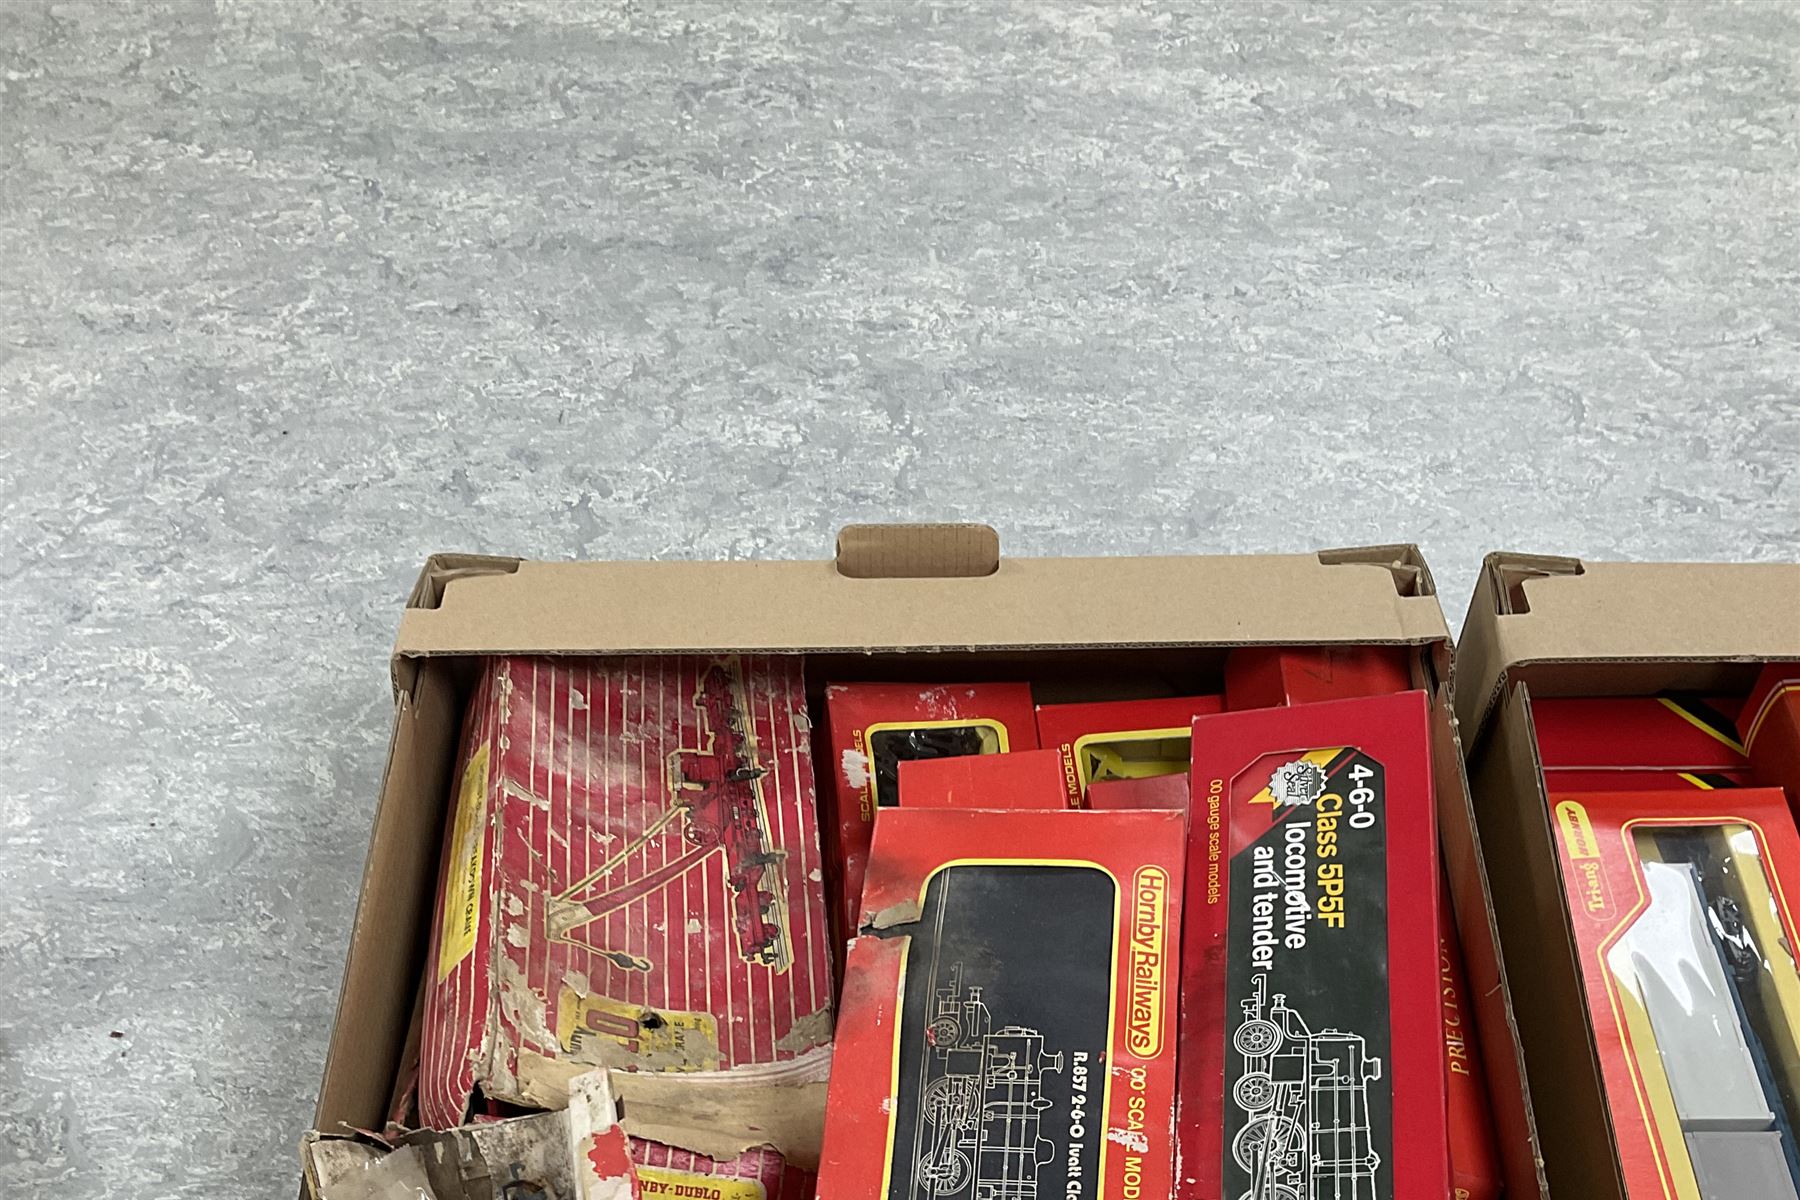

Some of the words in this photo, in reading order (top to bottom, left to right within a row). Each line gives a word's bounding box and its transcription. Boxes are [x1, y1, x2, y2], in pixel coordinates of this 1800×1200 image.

[1061, 743, 1078, 795] MODELS
[1283, 771, 1297, 799] Seal
[1296, 764, 1313, 800] Silver
[1207, 796, 1221, 830] gauge
[1348, 763, 1376, 829] 4-6-0
[1208, 831, 1220, 861] scale
[1315, 793, 1343, 859] Class
[1565, 806, 1588, 857] HORNBY
[1207, 863, 1221, 904] models
[1253, 846, 1279, 889] and
[1284, 821, 1312, 949] locomotive
[1131, 874, 1163, 949] Hornby
[1317, 863, 1345, 929] 5P5F
[1251, 891, 1279, 971] tender
[1127, 950, 1160, 1048] Railways
[1072, 1052, 1089, 1092] R.857
[1066, 1143, 1084, 1179] Ivatt
